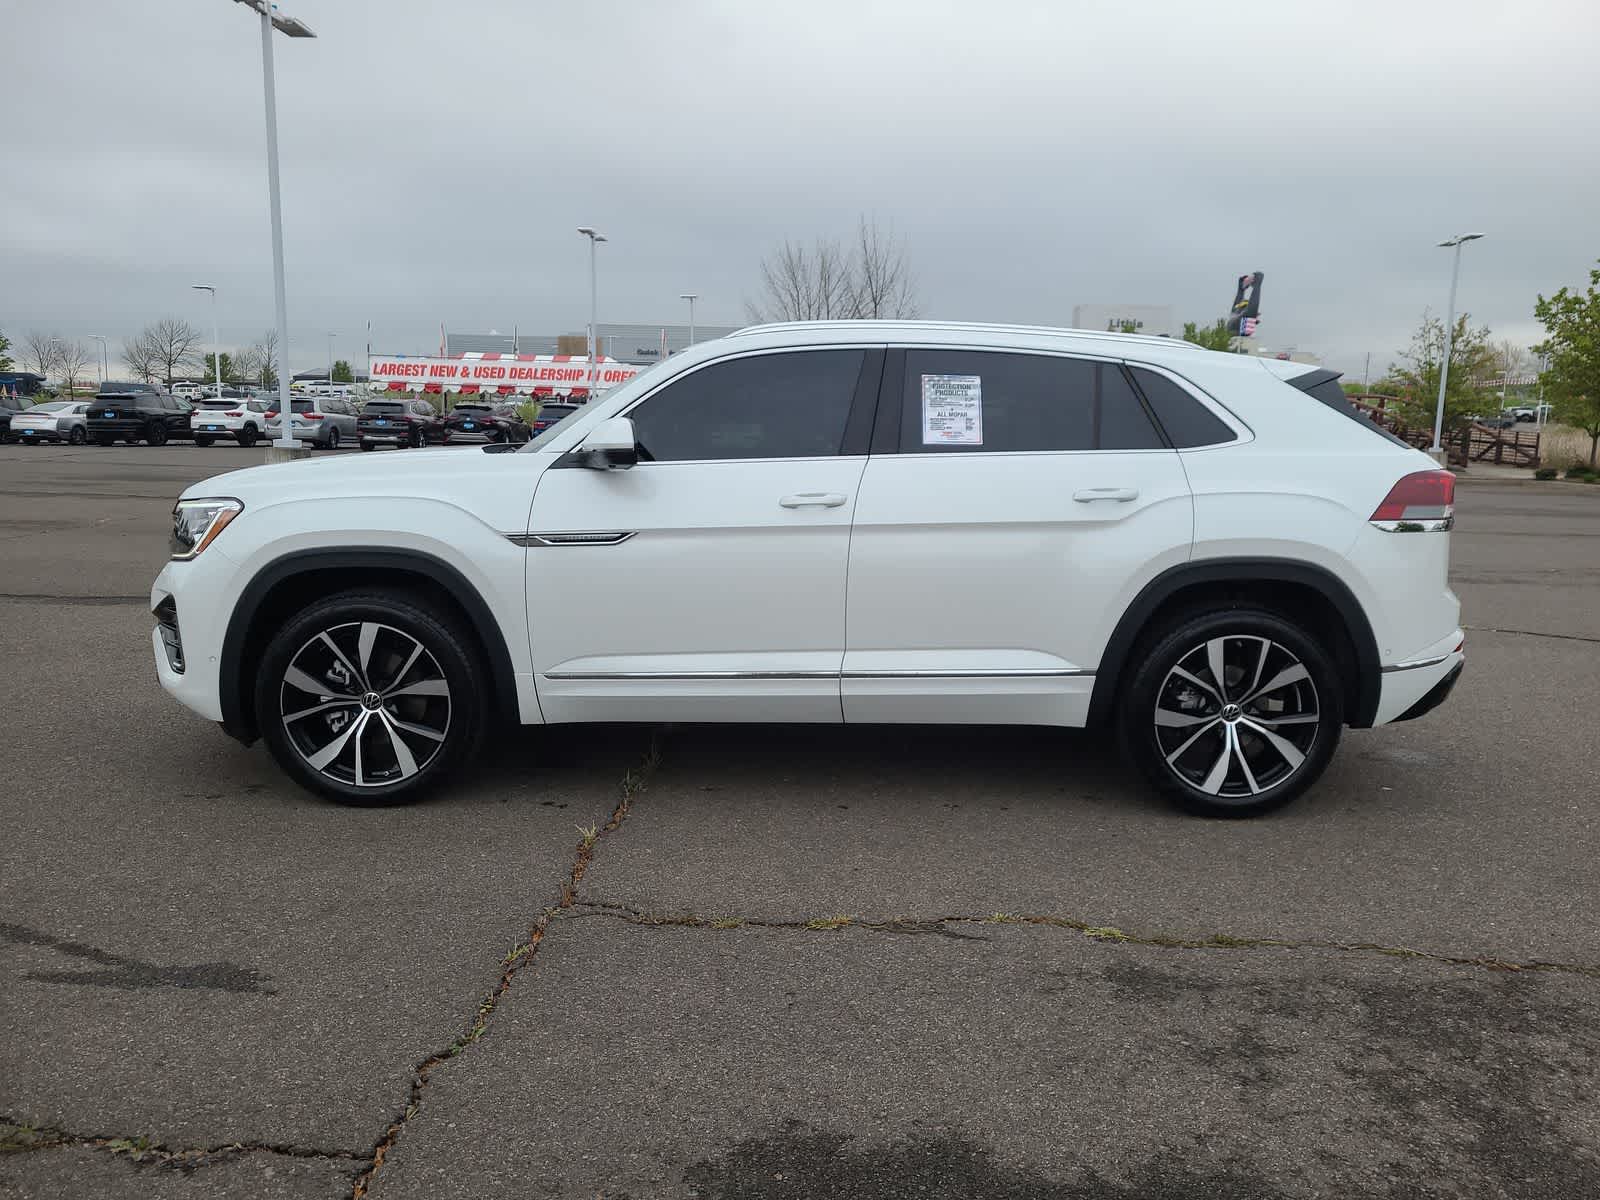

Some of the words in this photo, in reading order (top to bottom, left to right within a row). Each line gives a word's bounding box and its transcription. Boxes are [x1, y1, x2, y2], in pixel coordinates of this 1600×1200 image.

[373, 362, 428, 376] LARGEST
[429, 364, 458, 378] NEW
[460, 365, 471, 378] &
[474, 366, 506, 379] USED
[508, 367, 584, 382] DEALERSHIP
